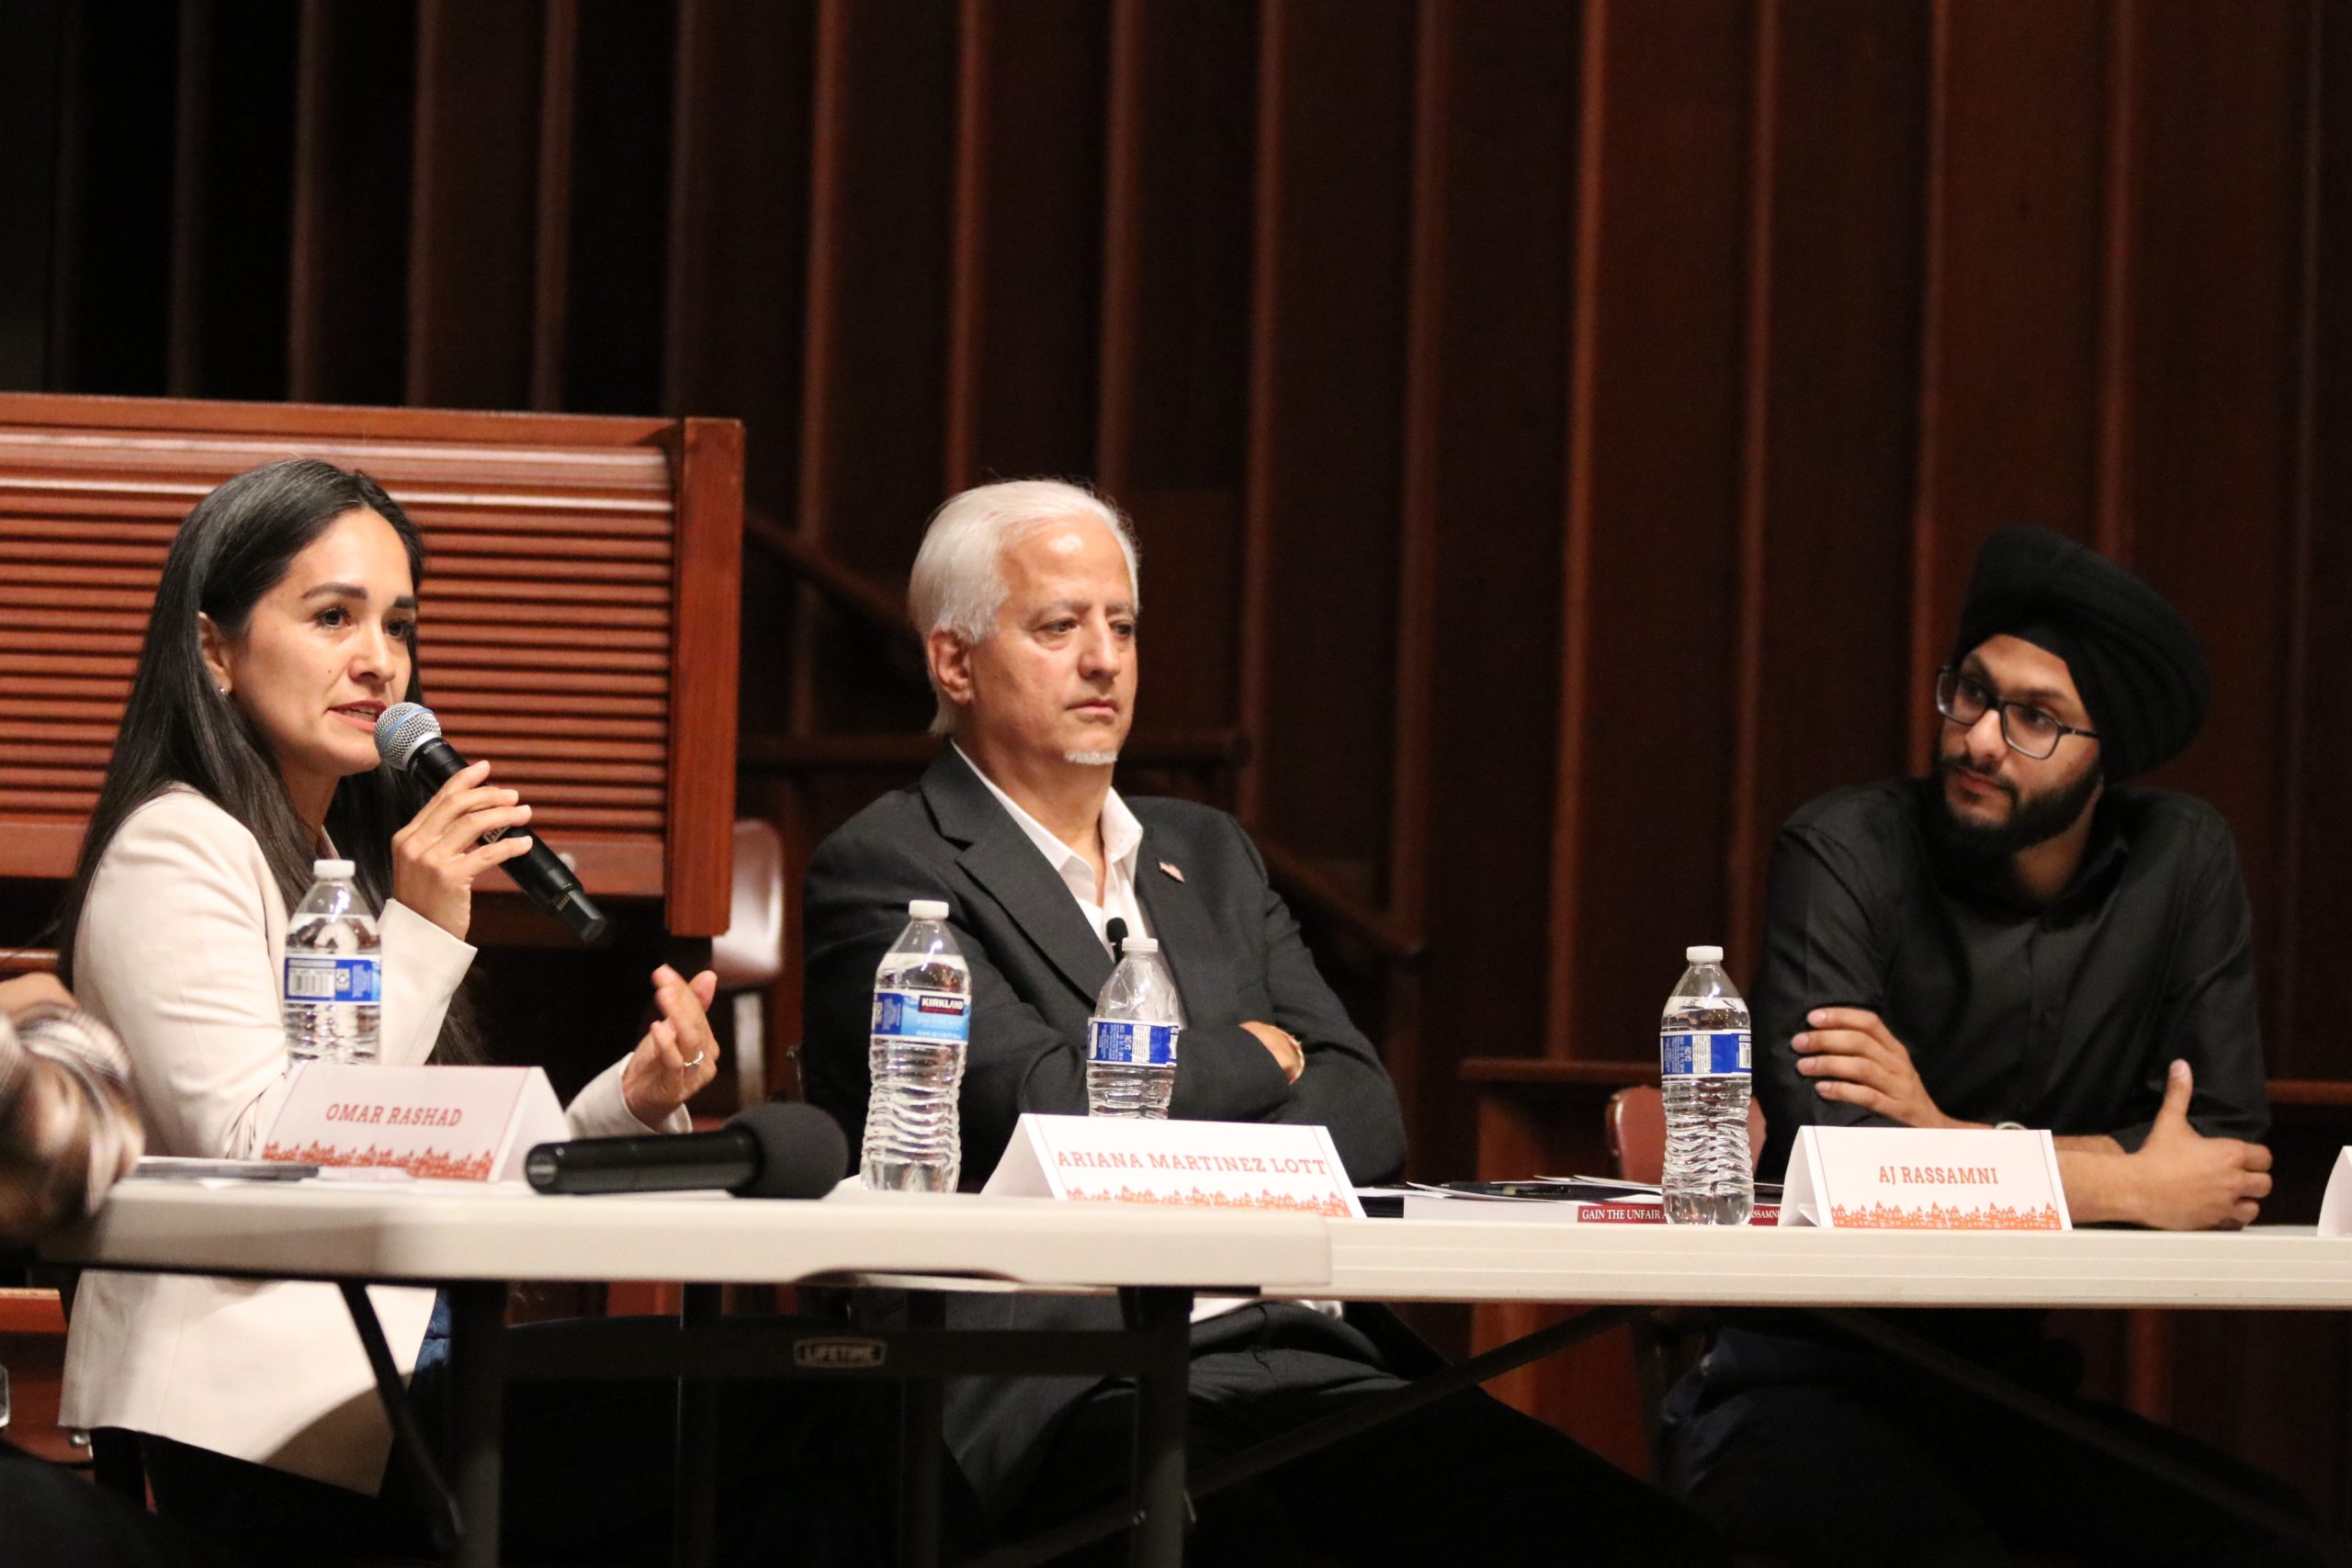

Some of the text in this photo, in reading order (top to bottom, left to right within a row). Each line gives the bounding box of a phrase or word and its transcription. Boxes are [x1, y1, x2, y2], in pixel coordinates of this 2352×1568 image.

[922, 998, 964, 1010] KIRKLAND
[325, 1103, 462, 1126] OMAR RASHAD
[1057, 1151, 1326, 1175] ARIANA MARTINEZ LOTT
[1879, 1166, 1999, 1185] AJ RASSAMNI
[1582, 1209, 1605, 1220] GAIN
[1606, 1209, 1625, 1220] THE
[1626, 1209, 1660, 1220] UNFAIR
[1752, 1210, 1780, 1219] SSAMNI
